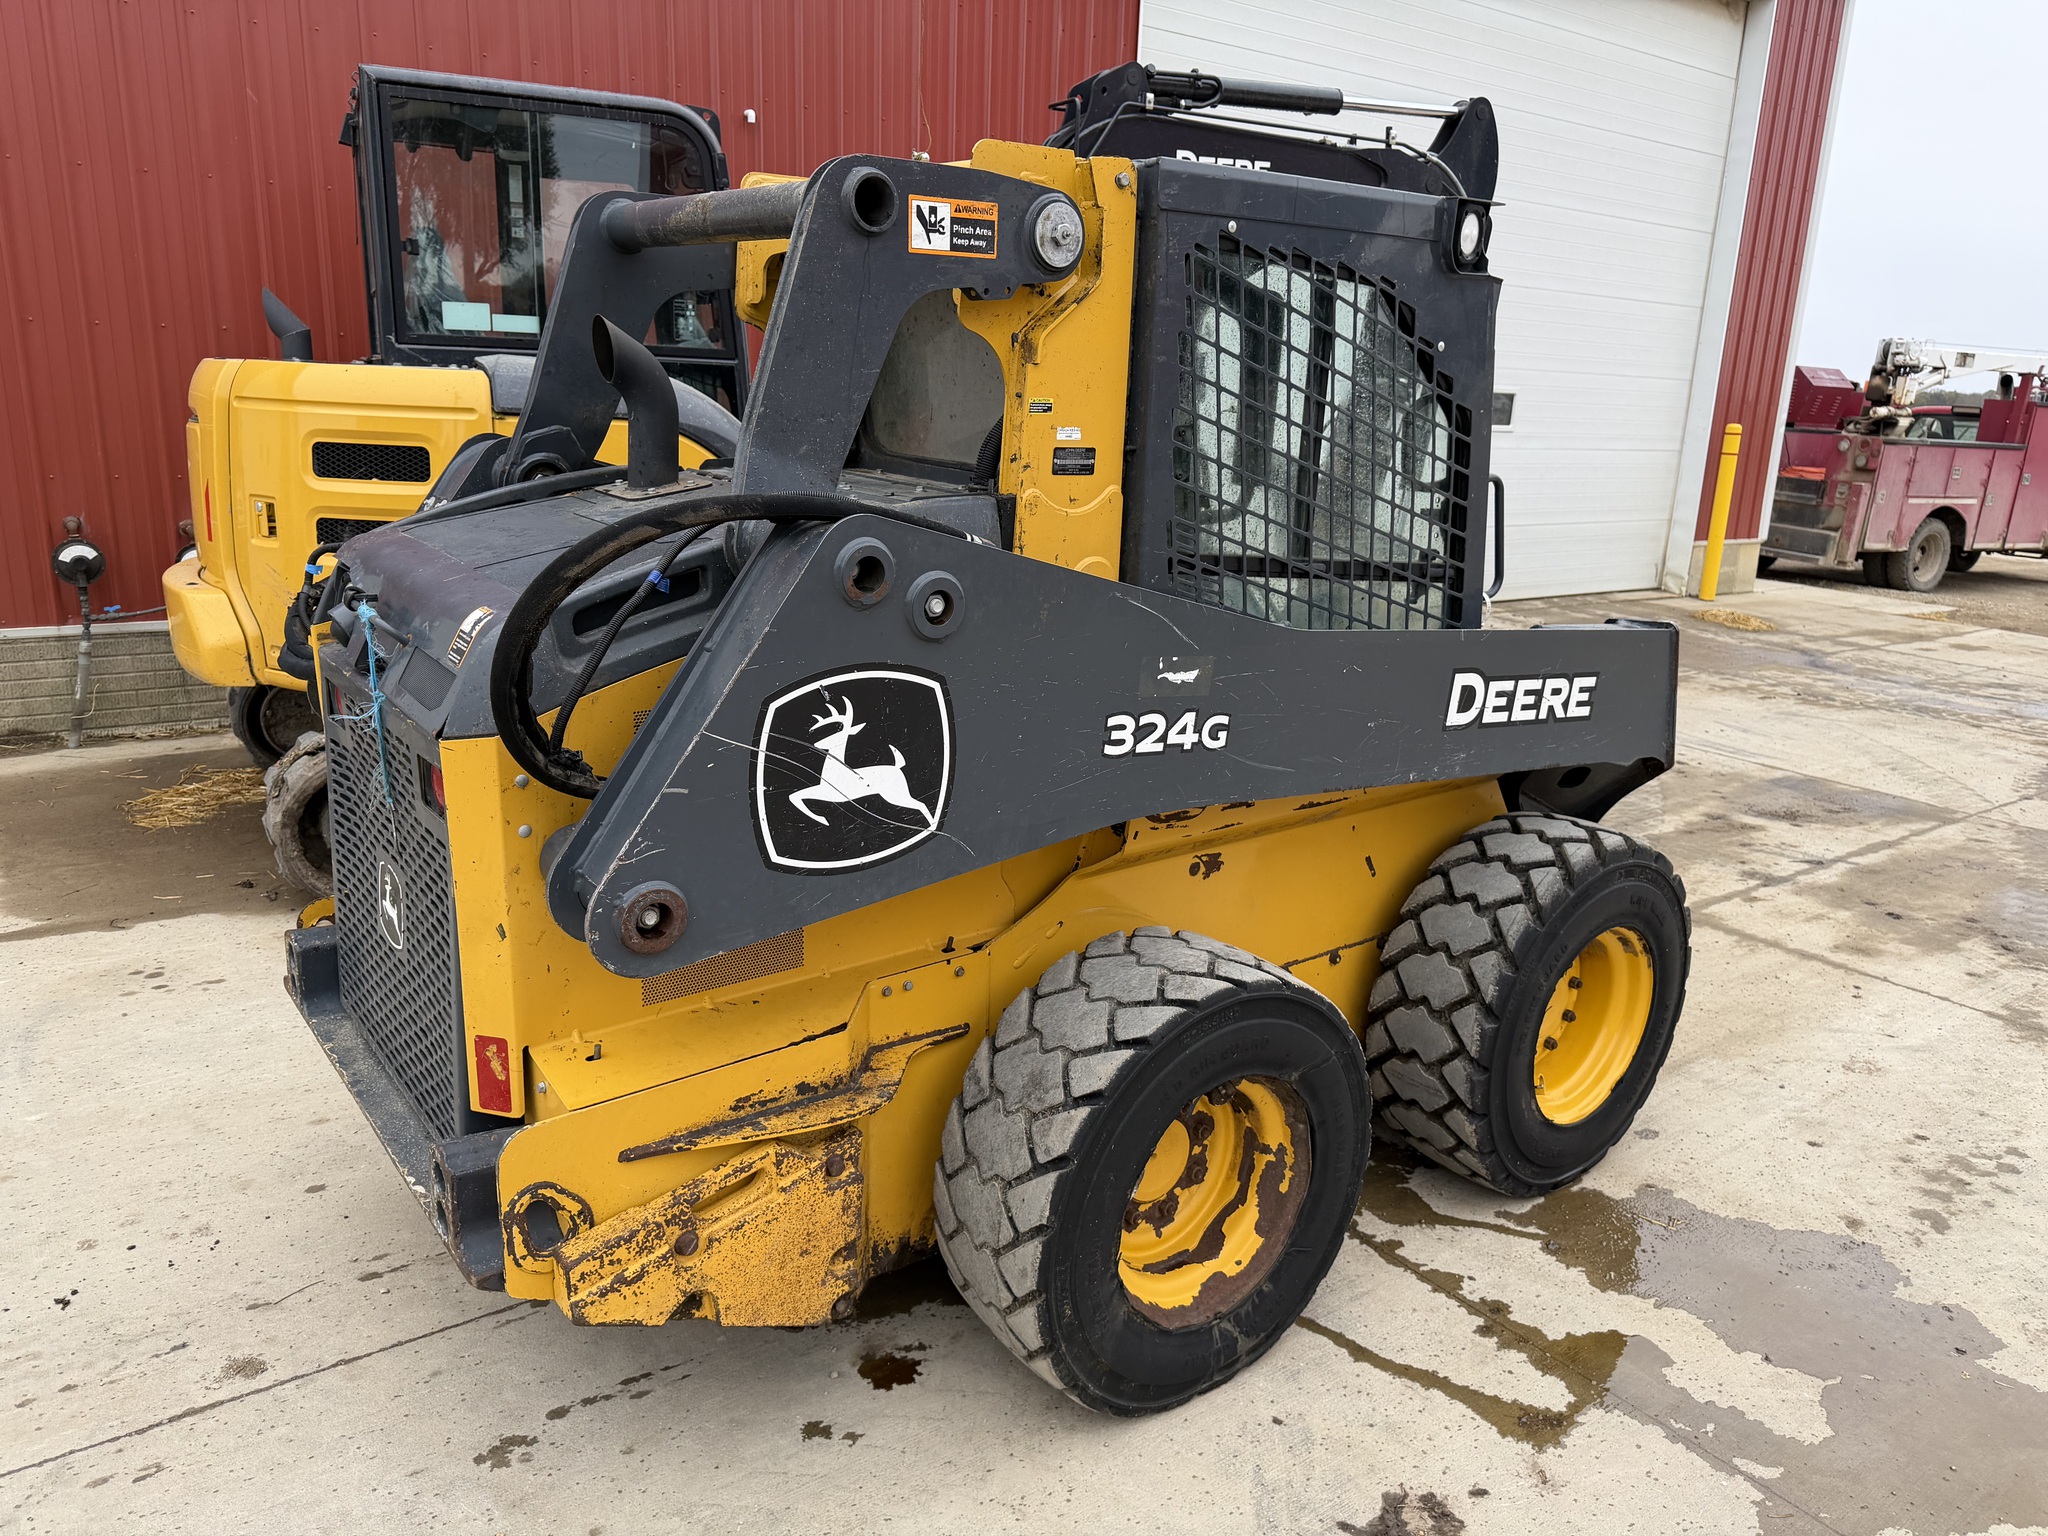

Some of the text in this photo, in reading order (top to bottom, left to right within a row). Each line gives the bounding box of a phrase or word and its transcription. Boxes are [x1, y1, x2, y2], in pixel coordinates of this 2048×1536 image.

[961, 206, 994, 217] WARNING
[953, 224, 992, 236] Pinch Area
[953, 237, 986, 248] Keep Away
[1446, 672, 1597, 727] DEERE
[1103, 711, 1230, 756] 324G
